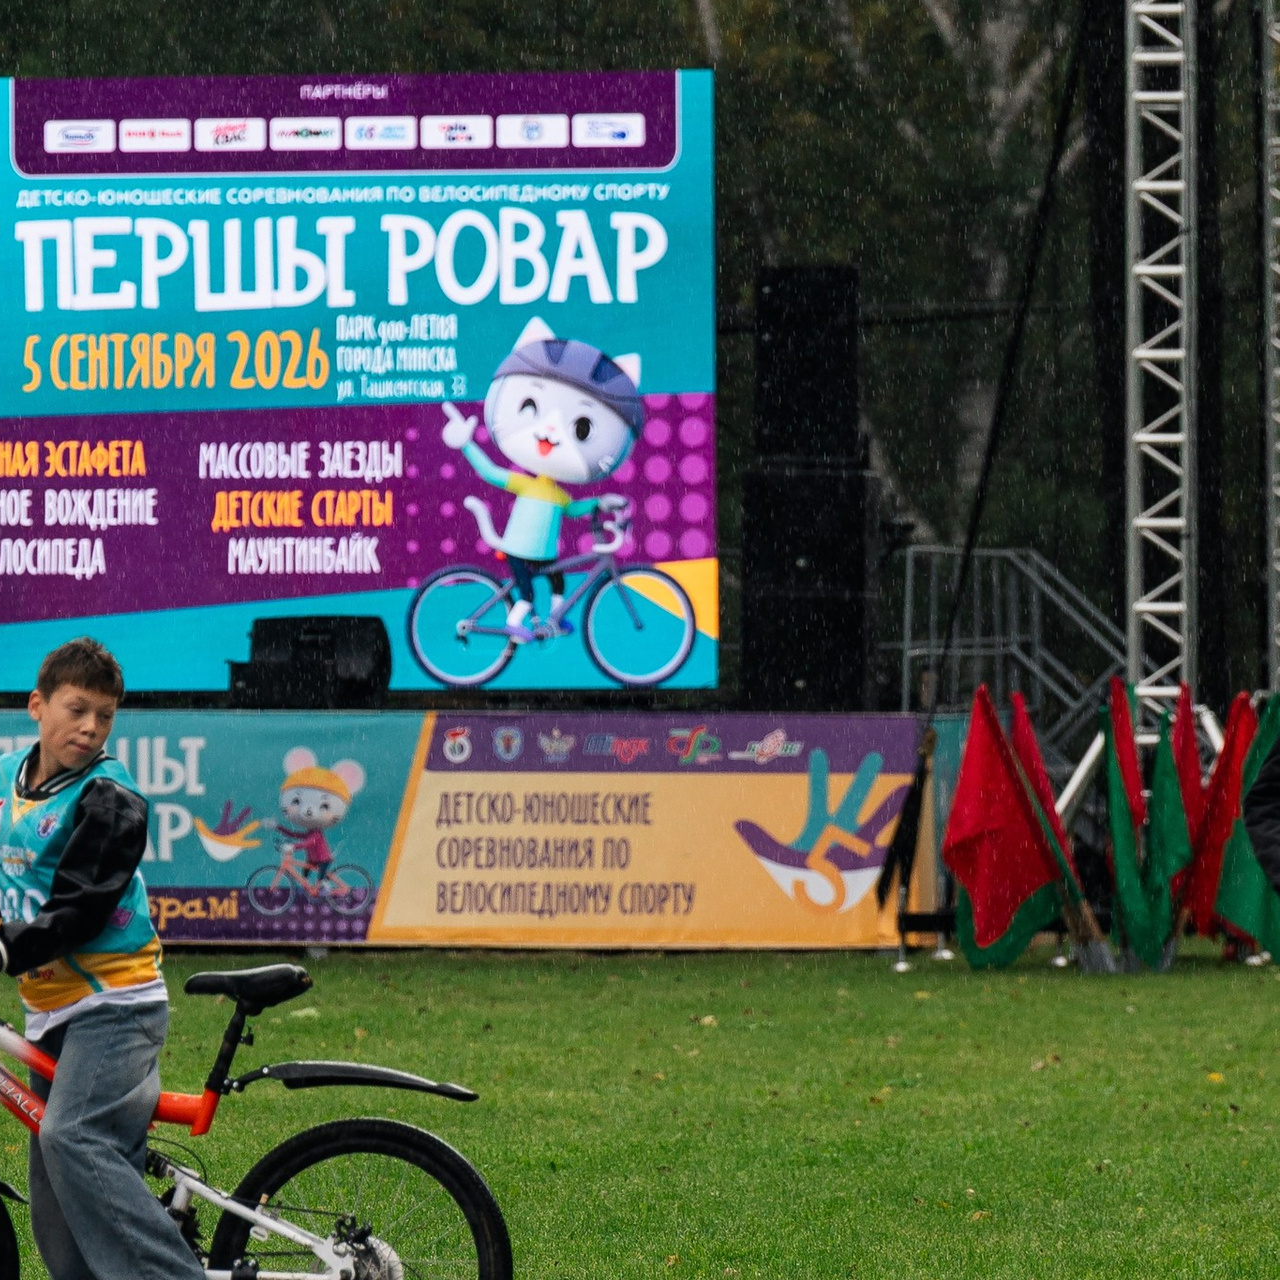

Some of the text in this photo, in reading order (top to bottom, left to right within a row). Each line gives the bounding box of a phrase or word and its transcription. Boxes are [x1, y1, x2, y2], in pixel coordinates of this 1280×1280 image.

[300, 81, 389, 100] ПАРТНЁРЫ
[16, 182, 671, 208] ДЕТСКО-ЮНОШЕСКИЕ СОРЕВНОВАНИЯ ПО ВЕЛОСИПЕДНОМУ СПОРТУ
[14, 206, 669, 312] ПЕРШЫ РОВАР
[335, 314, 377, 341] ПАРК
[21, 327, 330, 393] 5 СЕНТЯБРЯ 2026
[336, 345, 458, 375] ГОРОДА МИНСКА
[44, 440, 146, 478] ЭСТАФЕТА
[199, 440, 403, 484] МАССОВЫЕ ЗАЕЗДЫ
[44, 488, 159, 531] ВОЖДЕНИЕ
[211, 489, 394, 533] ДЕТСКИЕ СТАРТЫ
[227, 532, 381, 575] МАУНТИНБАЙК
[436, 791, 654, 829] ДЕТСКО-ЮНОШЕСКИЕ
[436, 836, 632, 870] СОРЕВНОВАНИЯ ПО
[436, 881, 696, 919] ВЕЛОСИПЕДНОМУ СПОРТУ
